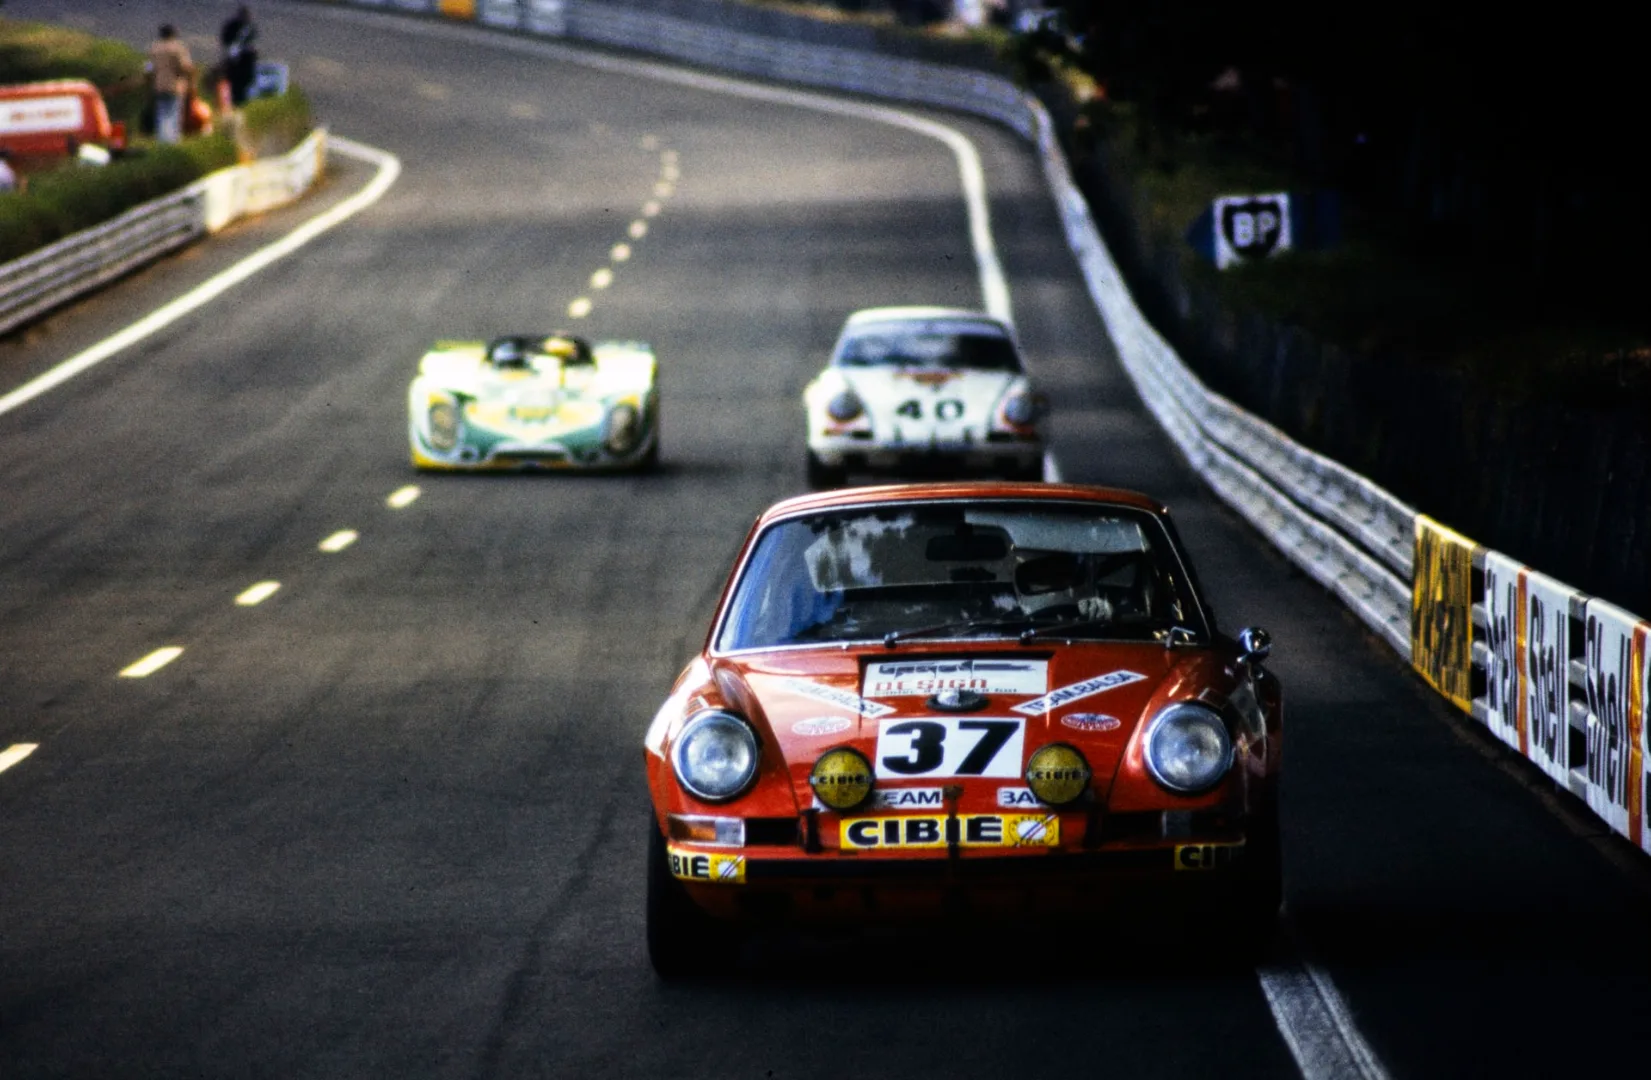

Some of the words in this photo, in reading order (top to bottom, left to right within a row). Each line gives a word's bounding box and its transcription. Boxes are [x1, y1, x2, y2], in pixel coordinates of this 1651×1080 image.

[1233, 211, 1276, 247] BP
[896, 398, 965, 421] 40
[1530, 594, 1567, 771] Shell
[1586, 614, 1631, 812] Shell
[881, 719, 1019, 775] 37
[883, 790, 941, 805] EAM
[847, 815, 1003, 847] CIBIE
[671, 853, 711, 879] BIE
